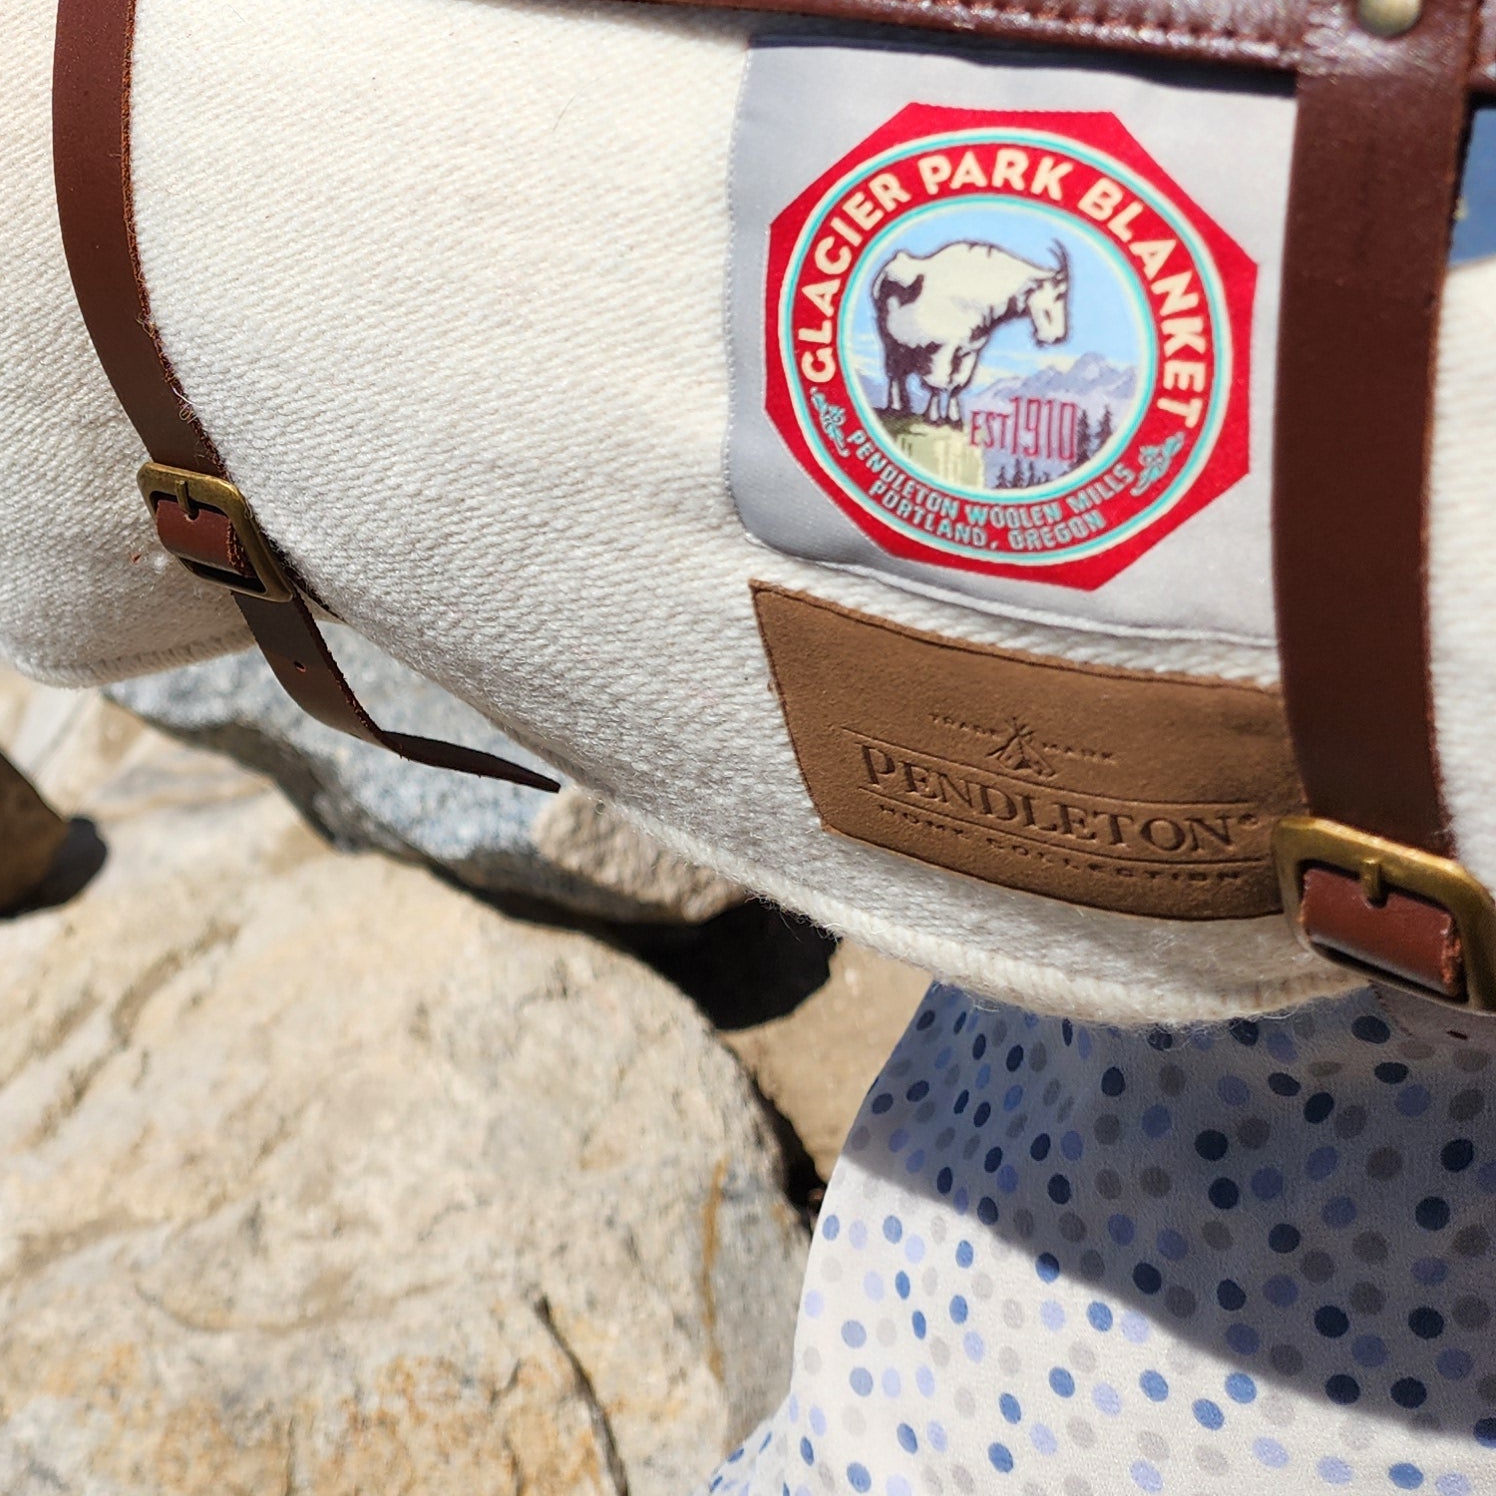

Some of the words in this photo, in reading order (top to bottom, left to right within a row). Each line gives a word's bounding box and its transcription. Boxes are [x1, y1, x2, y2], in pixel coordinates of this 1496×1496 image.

[798, 173, 911, 384] GLACIER
[917, 148, 1075, 202] PARK
[1078, 177, 1208, 430] BLANKET
[970, 409, 1010, 449] EST
[1009, 396, 1077, 461] 1910
[847, 429, 959, 520] PENDLETON
[964, 500, 1062, 529] WOOLEN
[1066, 462, 1135, 515] MILLS
[1008, 510, 1107, 551] OREGON
